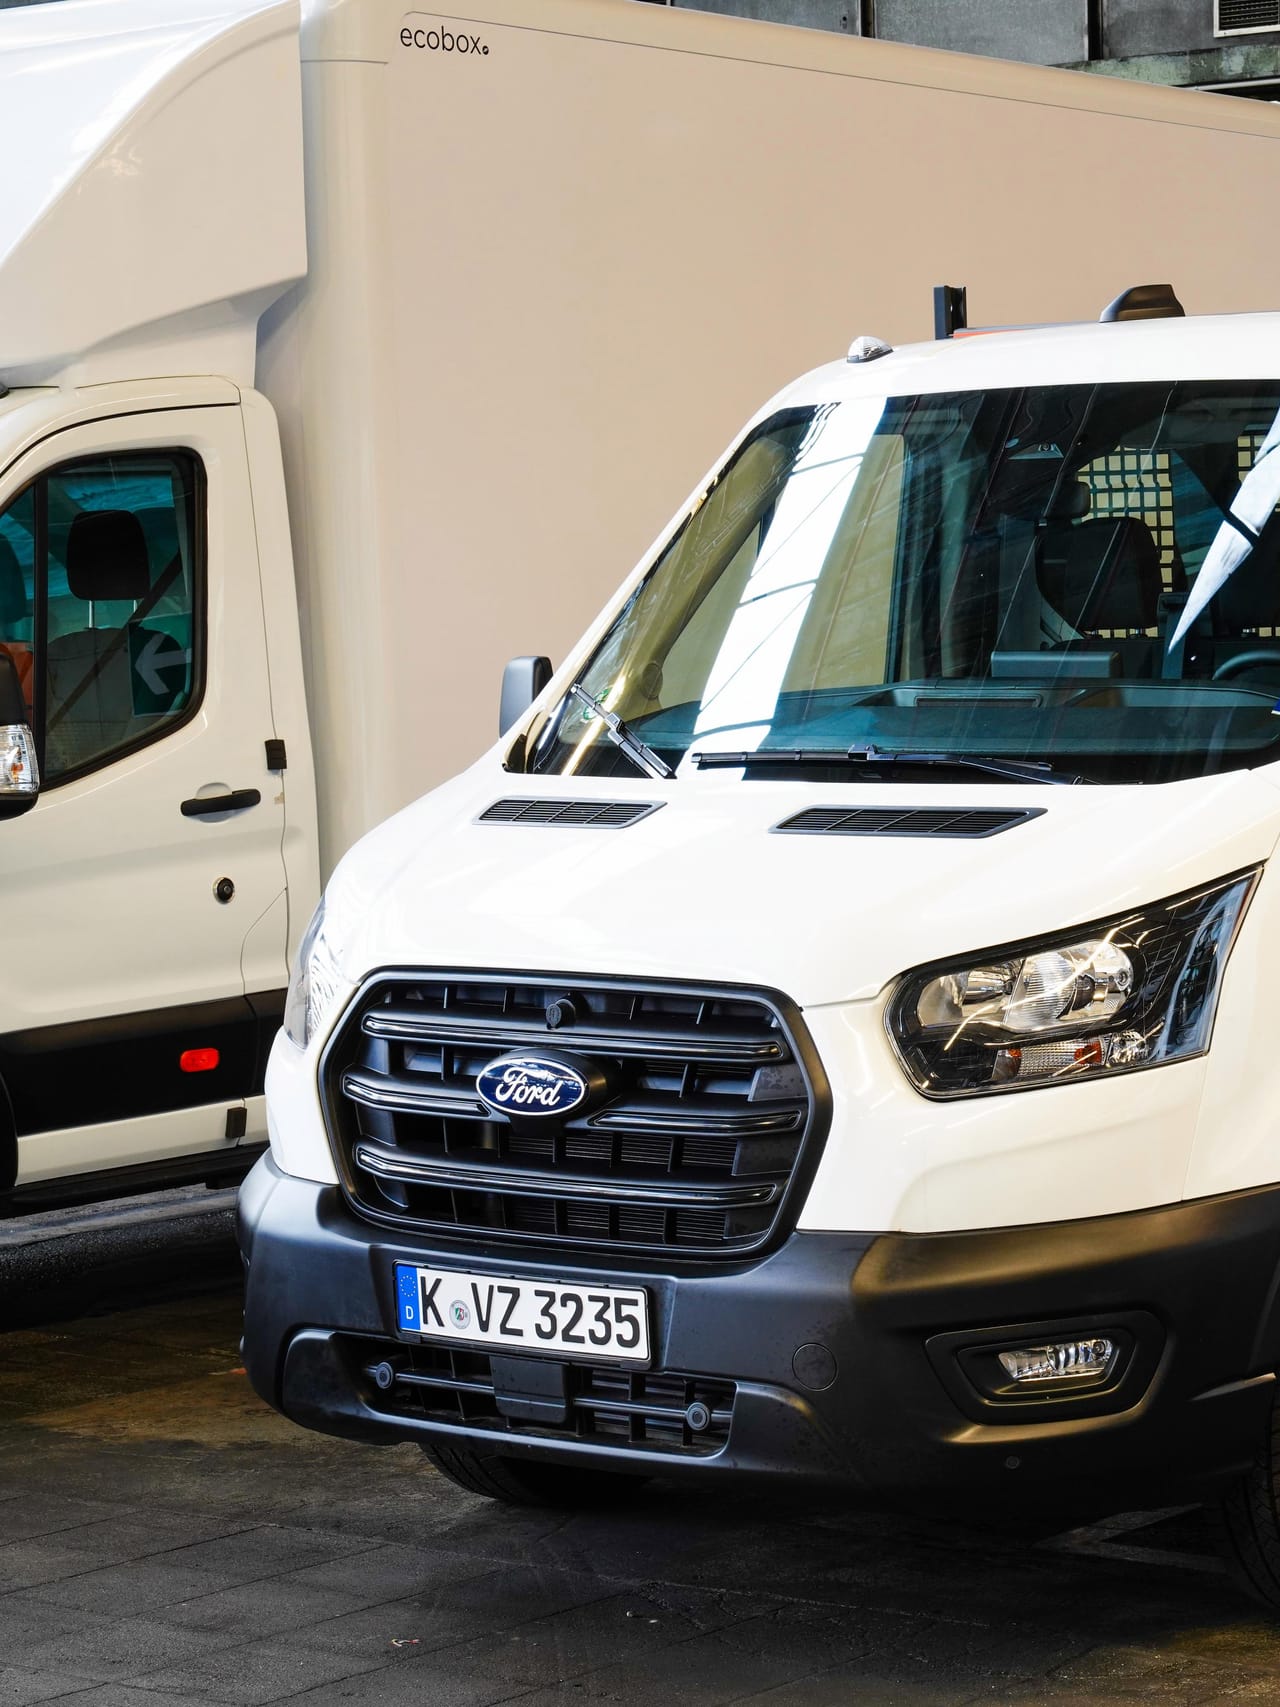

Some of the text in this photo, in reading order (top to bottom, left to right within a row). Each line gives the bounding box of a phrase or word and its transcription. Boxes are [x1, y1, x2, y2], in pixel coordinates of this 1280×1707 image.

[495, 1066, 561, 1106] Ford
[405, 1305, 414, 1320] D
[420, 1276, 640, 1348] K VZ 3235
